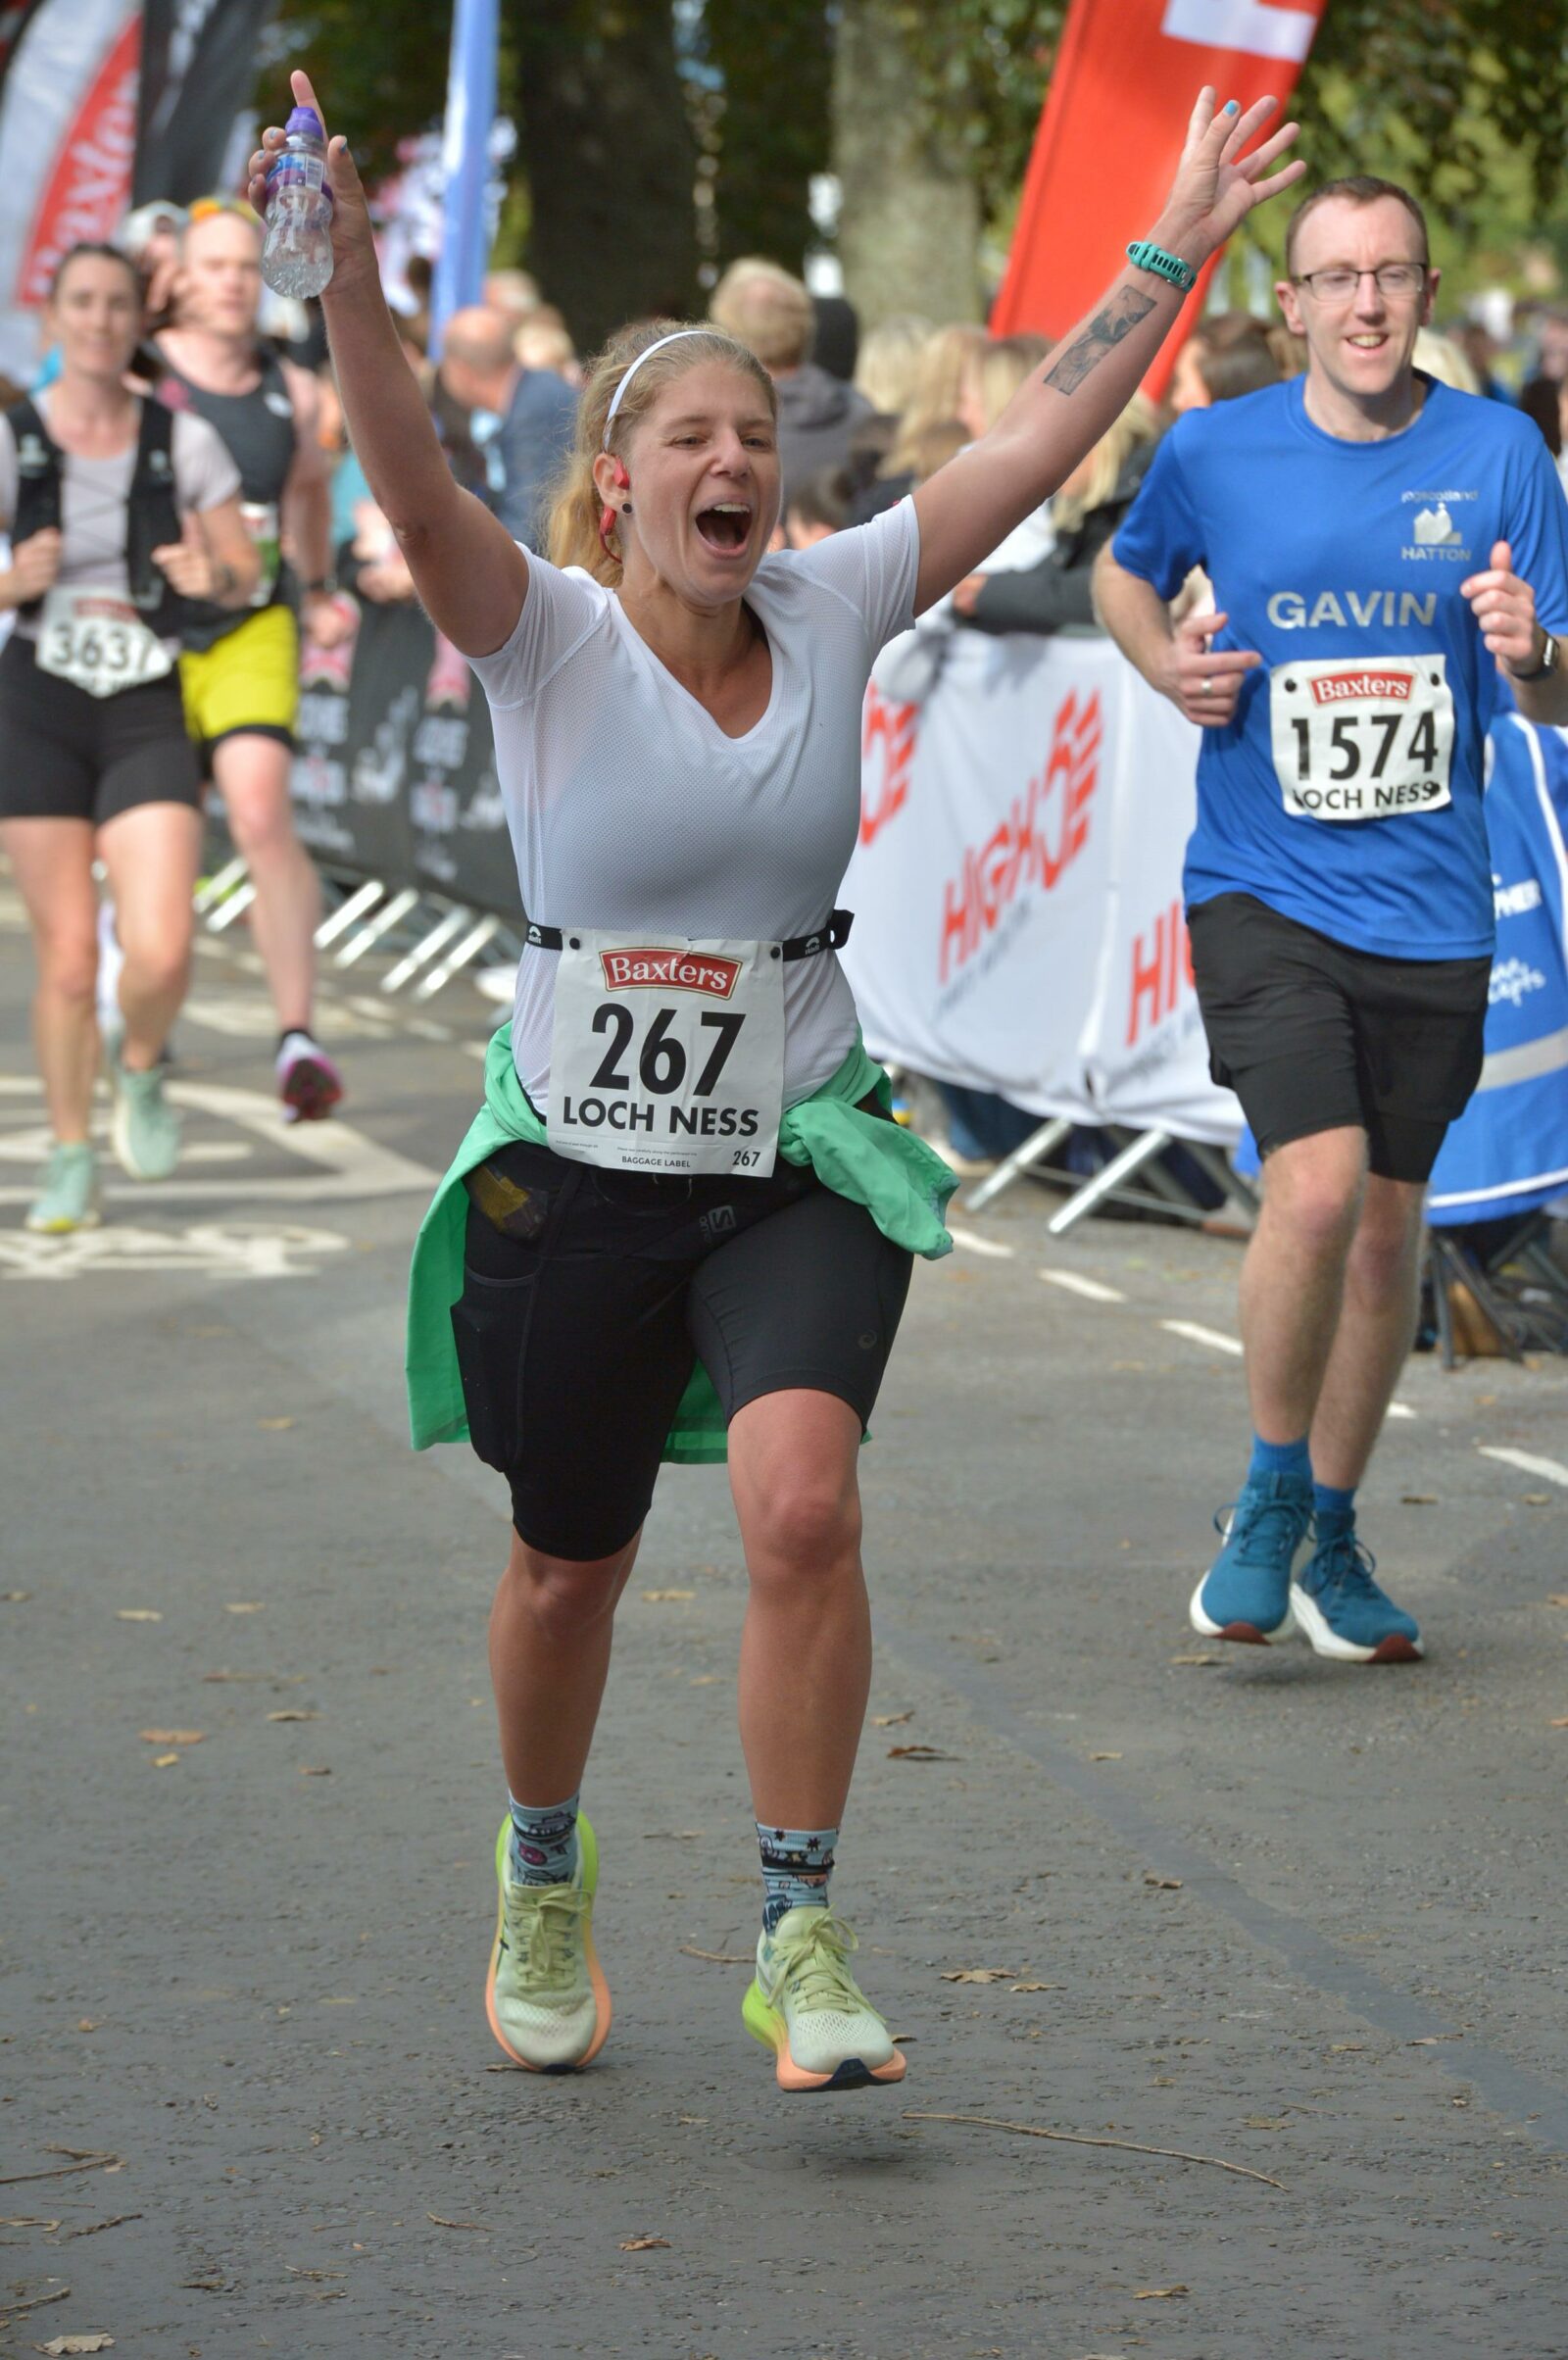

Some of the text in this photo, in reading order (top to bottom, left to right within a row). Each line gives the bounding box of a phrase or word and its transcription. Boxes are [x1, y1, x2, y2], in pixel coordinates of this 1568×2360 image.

[1401, 547, 1471, 563] HATTON
[1267, 591, 1437, 629] GAVIN
[1316, 674, 1409, 702] Baxters
[1292, 711, 1439, 781] 1574
[1293, 781, 1439, 811] OCH NESS
[611, 957, 728, 990] Baxters
[589, 1003, 747, 1097] 267
[564, 1096, 760, 1137] LOCH NESS
[621, 1151, 760, 1168] BAGGAGE LABEL 267
